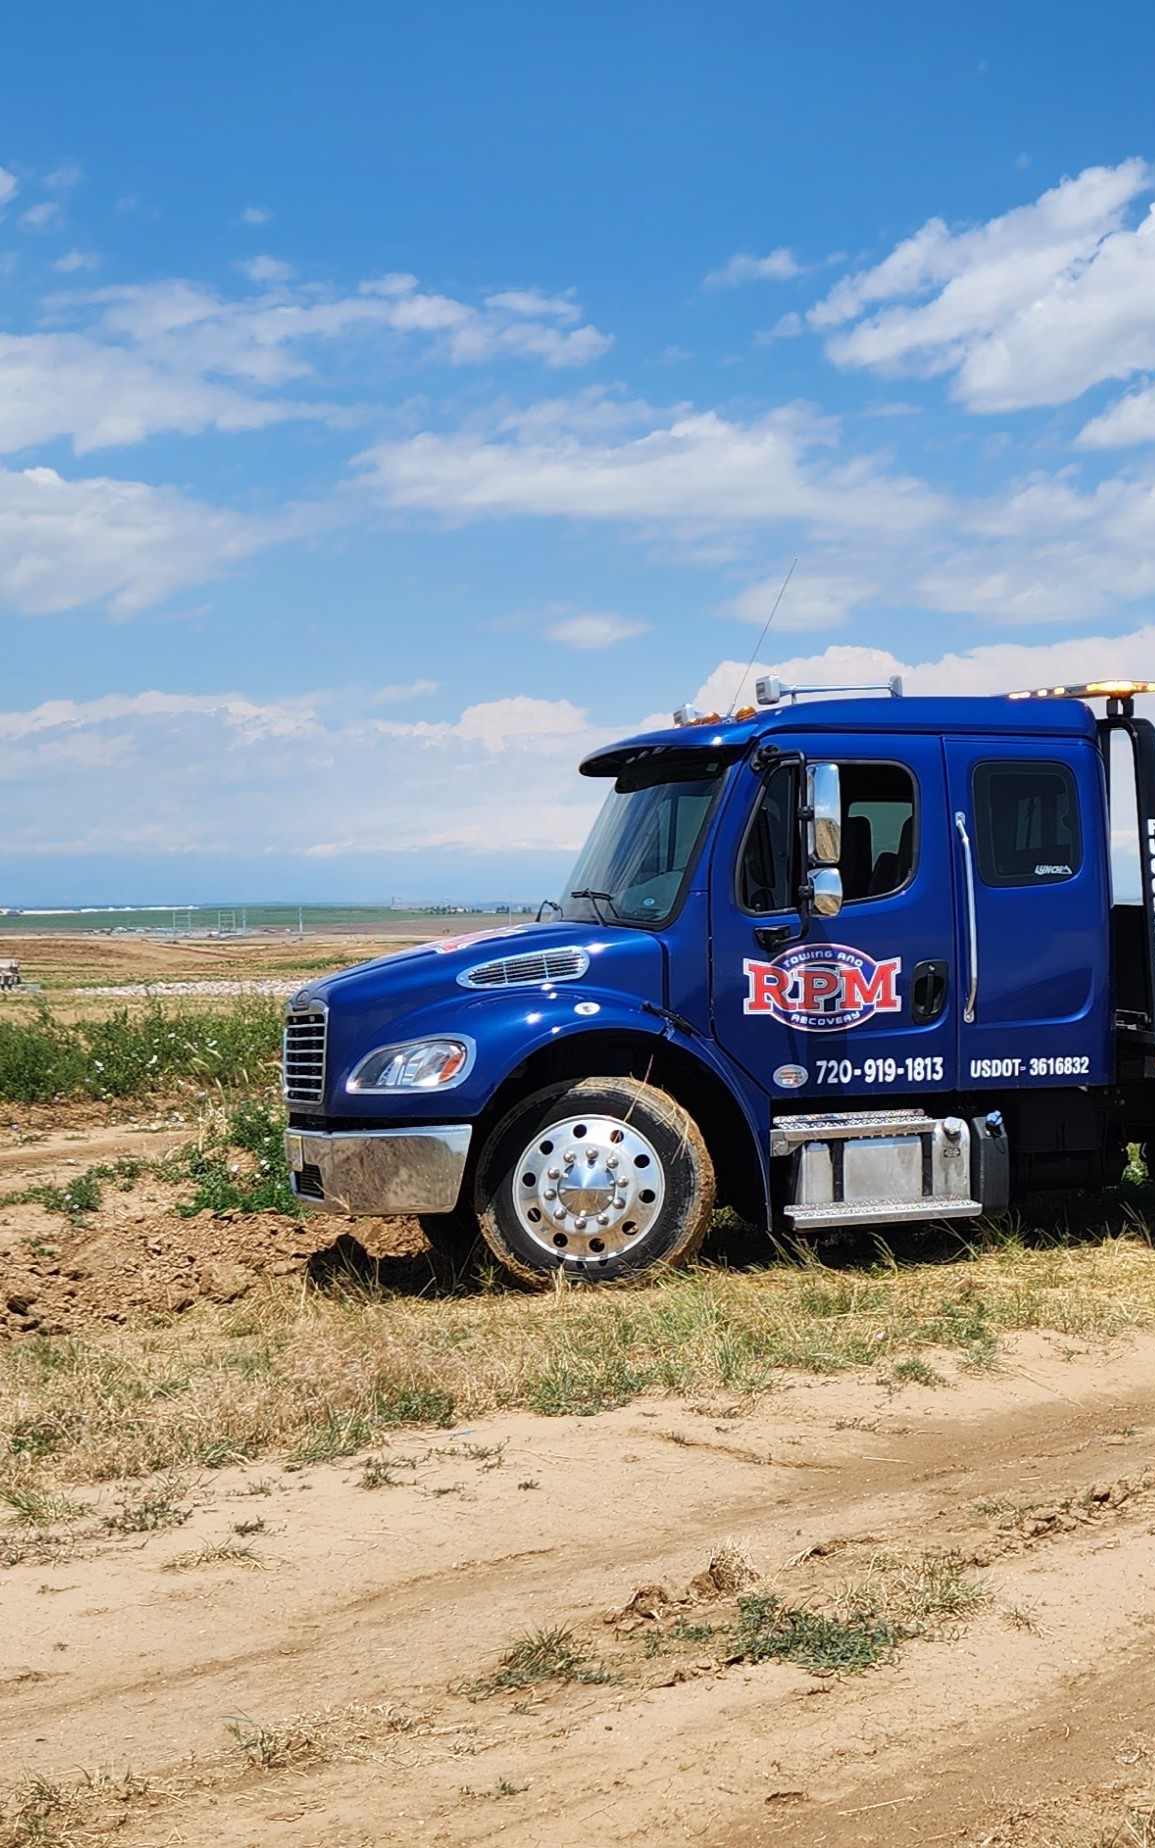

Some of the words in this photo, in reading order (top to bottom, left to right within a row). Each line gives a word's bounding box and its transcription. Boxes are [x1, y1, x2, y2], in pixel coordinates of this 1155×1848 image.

[782, 950, 833, 968] TOWING
[837, 952, 864, 968] AND
[744, 958, 901, 1014] RPM
[790, 1010, 861, 1026] RECOVERY
[816, 1056, 944, 1085] 720-919-1813
[1029, 1056, 1090, 1076] 3616832
